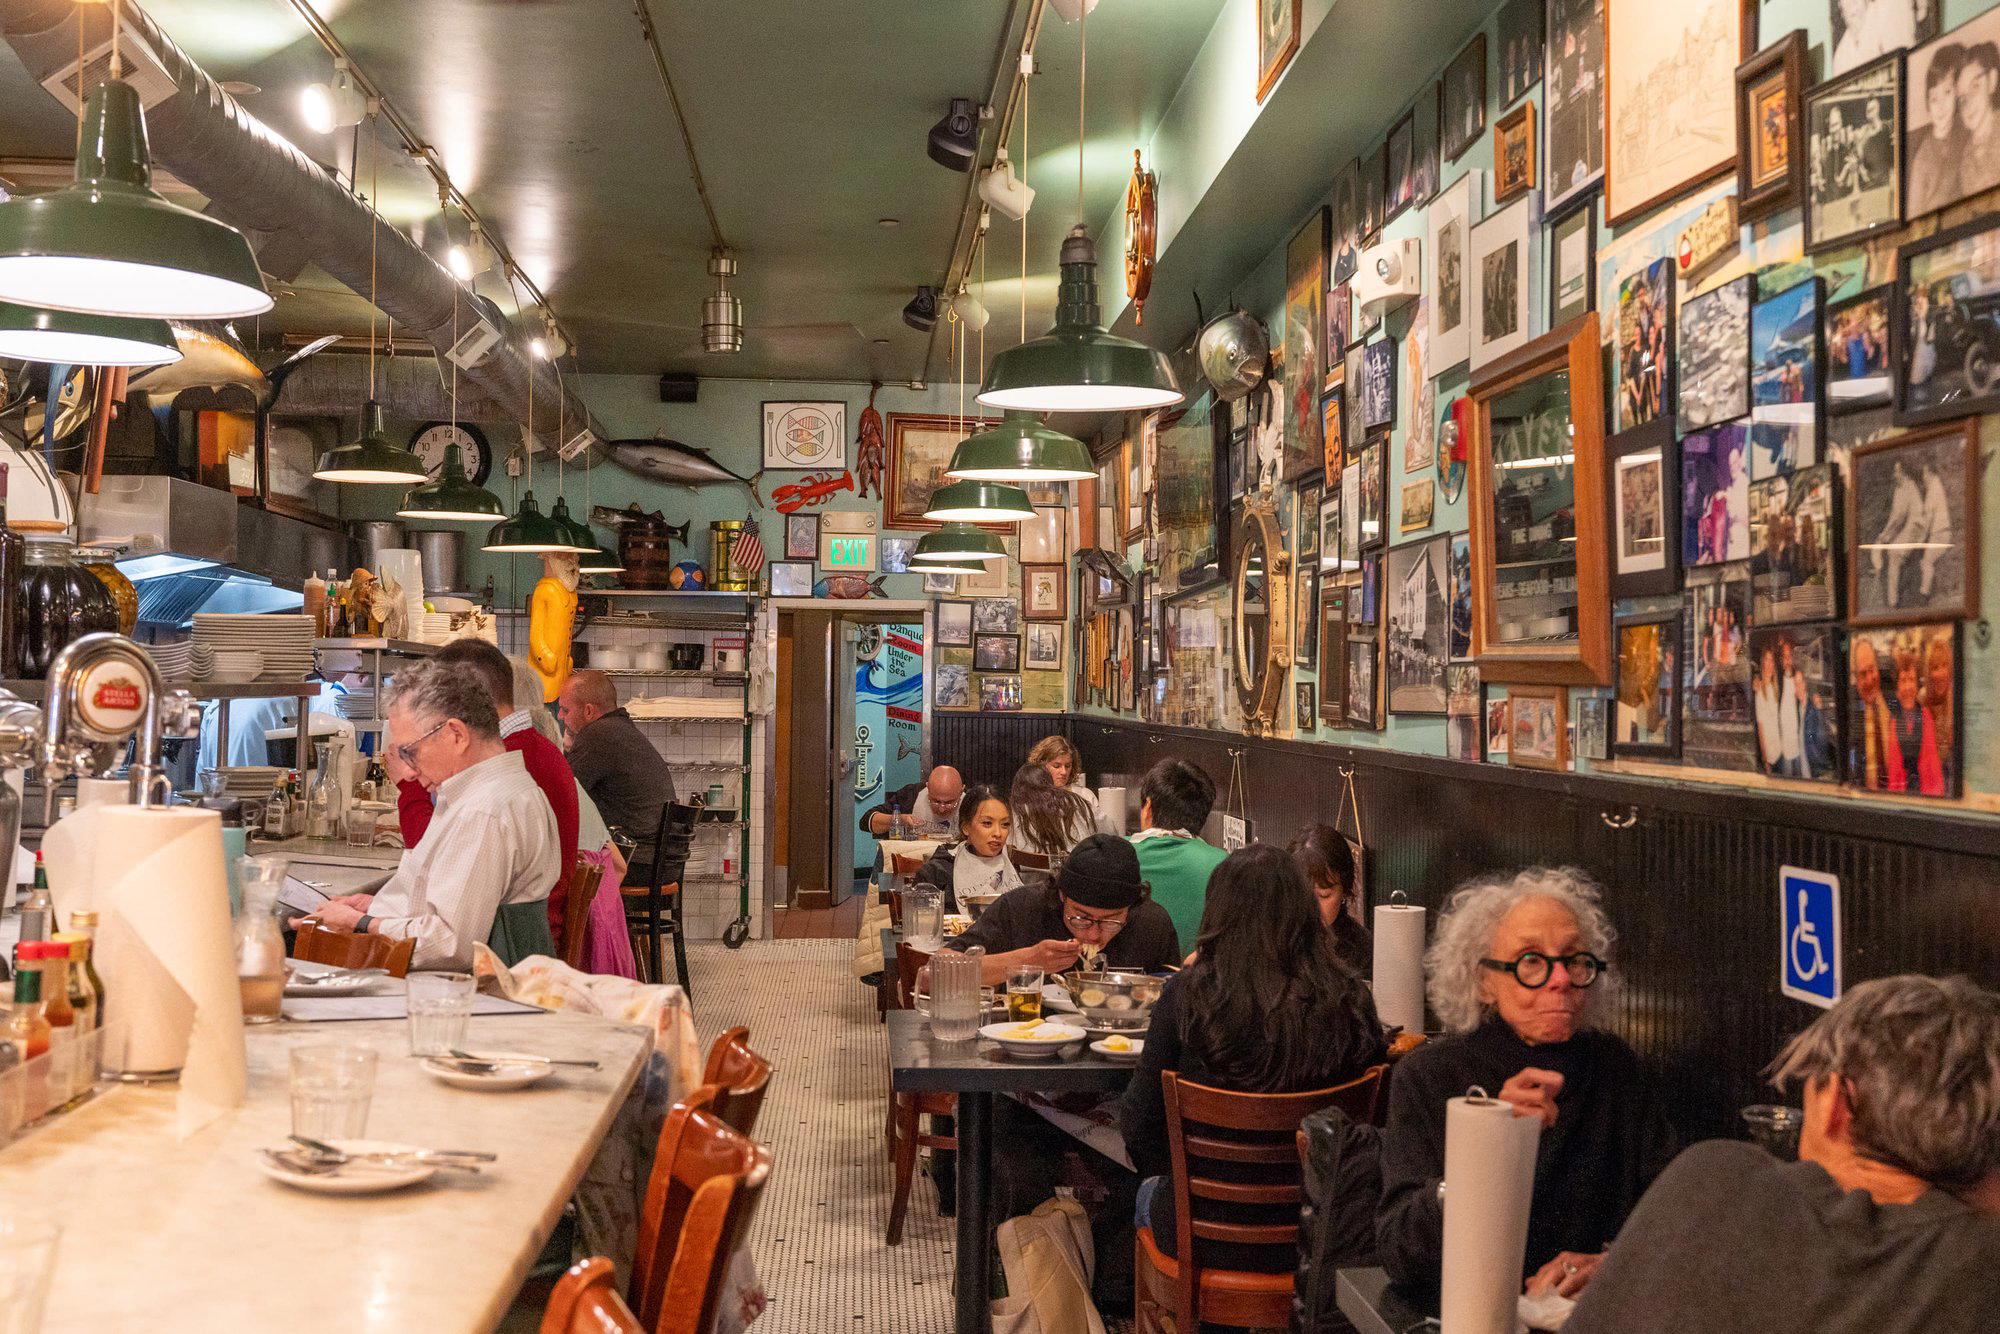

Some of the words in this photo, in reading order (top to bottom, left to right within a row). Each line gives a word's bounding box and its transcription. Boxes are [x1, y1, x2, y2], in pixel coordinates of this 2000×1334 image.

[432, 433, 437, 442] 11
[444, 429, 453, 438] 12
[422, 442, 430, 451] 10
[466, 442, 473, 451] 2
[419, 454, 426, 462] 9
[471, 455, 476, 463] 3
[466, 467, 473, 476] 4
[831, 538, 869, 566] EXIT
[889, 624, 923, 641] Banque
[887, 645, 914, 662] Under
[891, 656, 906, 668] the
[888, 664, 906, 677] Sea
[888, 718, 917, 731] Room
[859, 749, 867, 788] WELCOME
